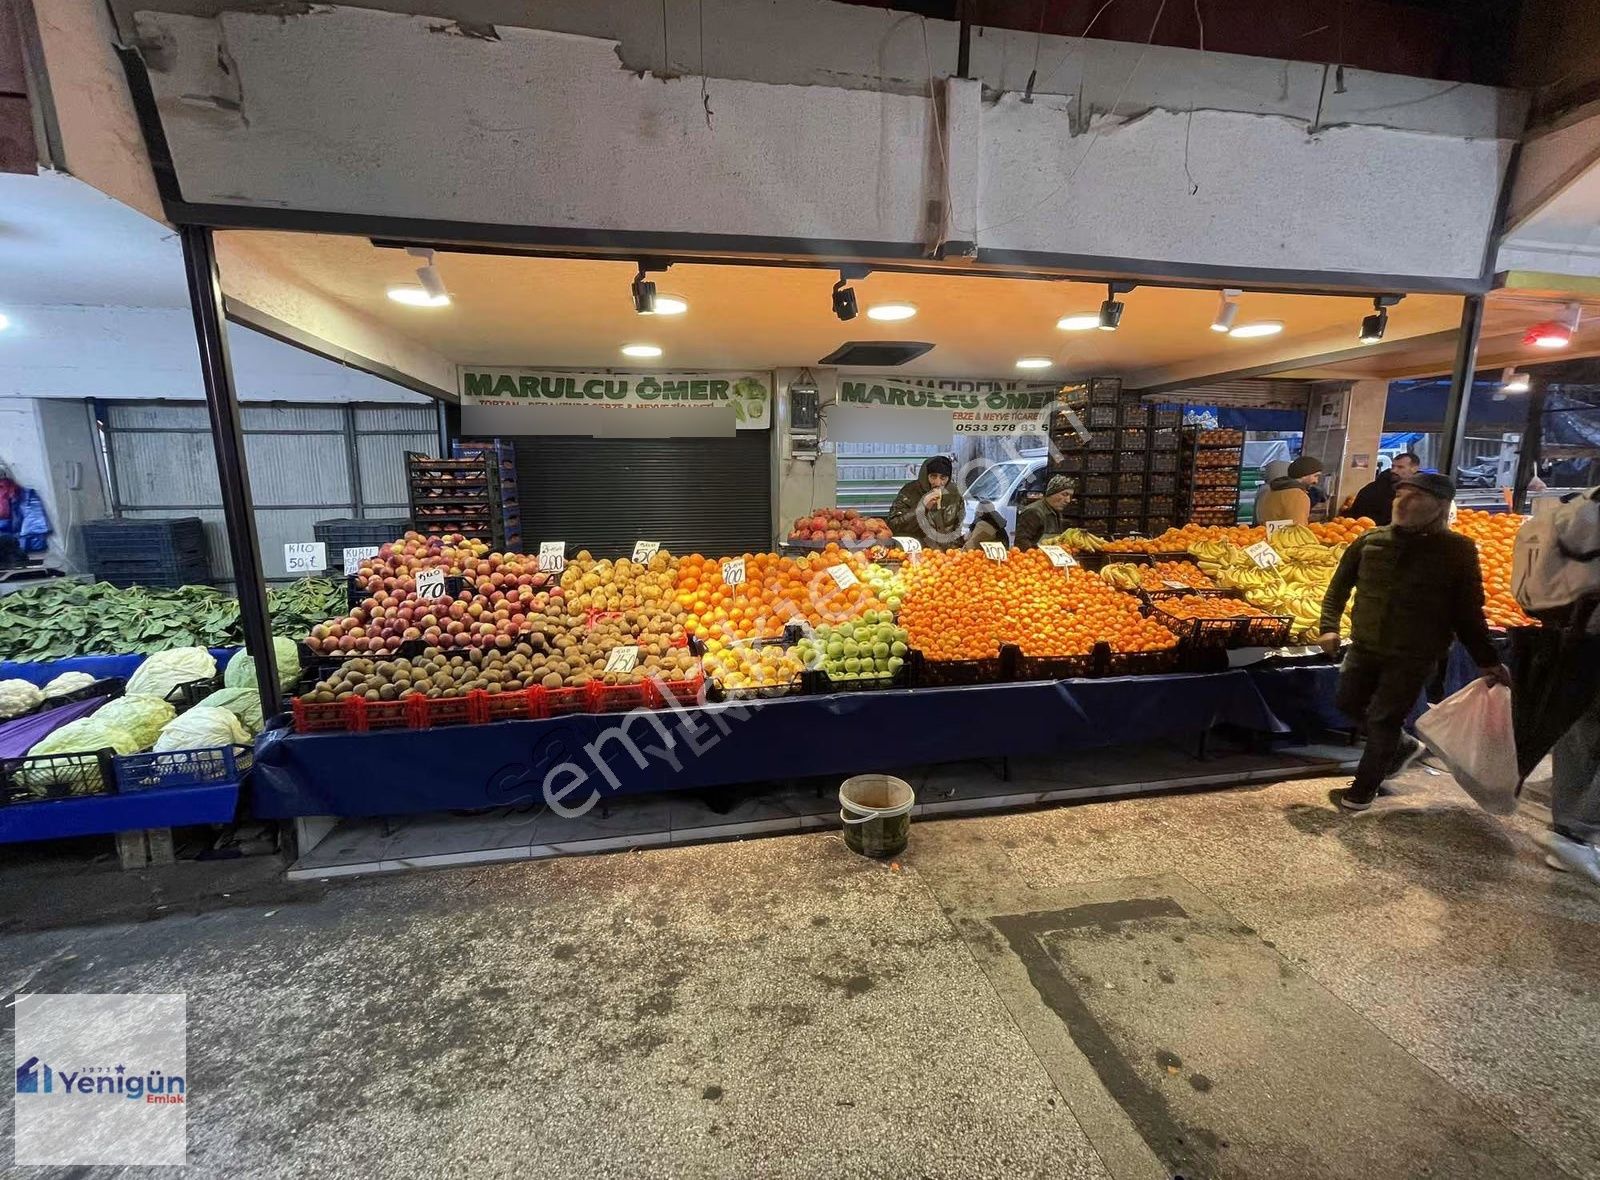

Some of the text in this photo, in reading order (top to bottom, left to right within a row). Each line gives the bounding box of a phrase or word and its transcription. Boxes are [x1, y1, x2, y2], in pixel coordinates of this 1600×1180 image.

[464, 373, 729, 400] MARULCU ÖMER
[841, 382, 979, 409] MARULCU
[953, 412, 975, 421] EBZE
[982, 412, 1010, 421] MEYVE
[955, 424, 988, 432] 0533
[992, 424, 1016, 432] 578
[1042, 424, 1050, 432] 5
[419, 582, 445, 598] 70
